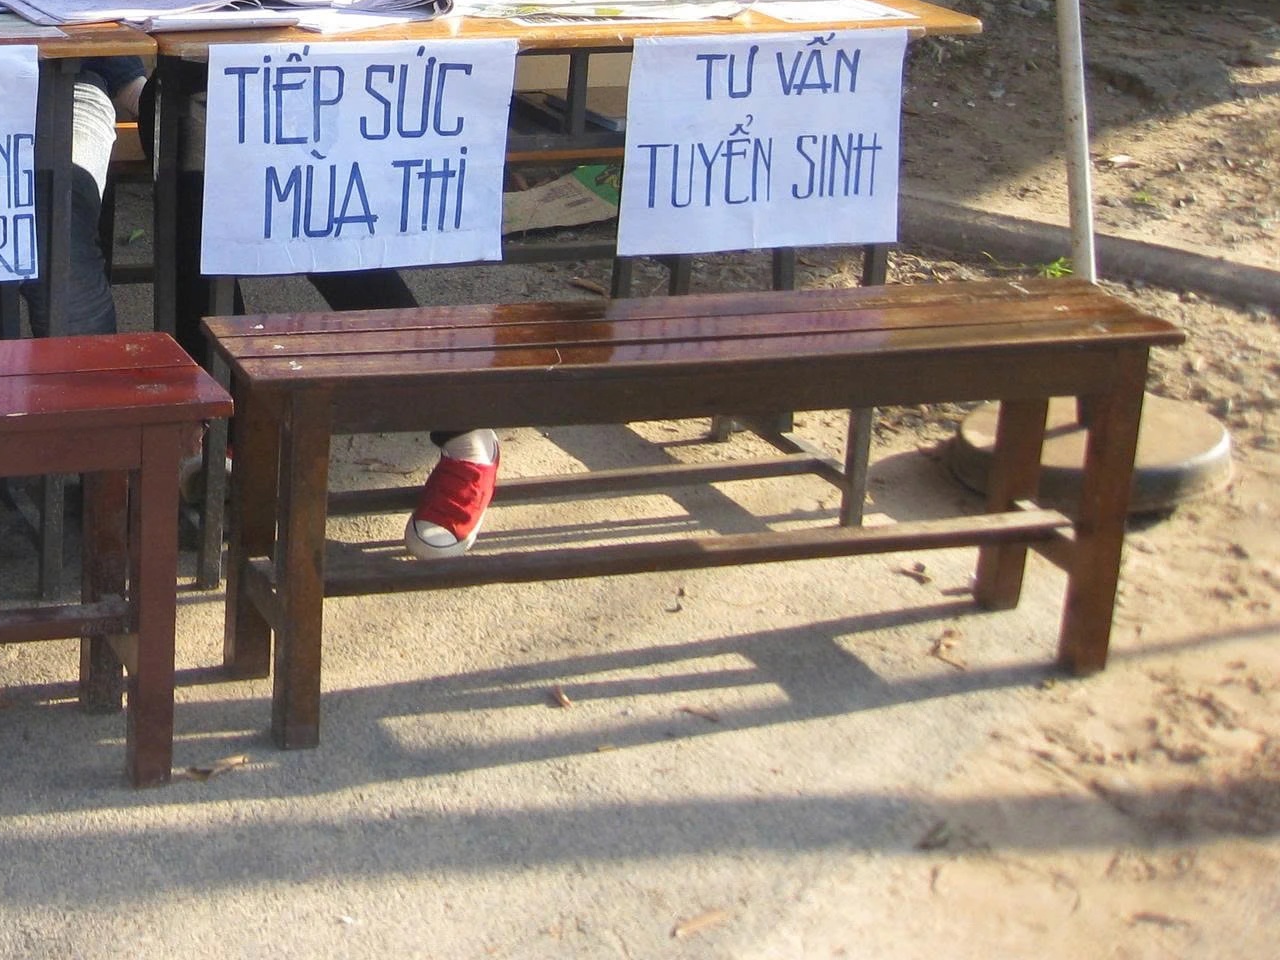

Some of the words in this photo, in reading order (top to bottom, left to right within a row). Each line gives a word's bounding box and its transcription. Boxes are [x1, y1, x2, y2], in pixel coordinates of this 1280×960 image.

[360, 45, 473, 140] SỨC
[696, 45, 759, 100] TƯ
[776, 32, 861, 96] VẤN
[264, 149, 379, 239] MÙA
[637, 114, 772, 208] TUYỂN
[792, 133, 882, 199] SINH
